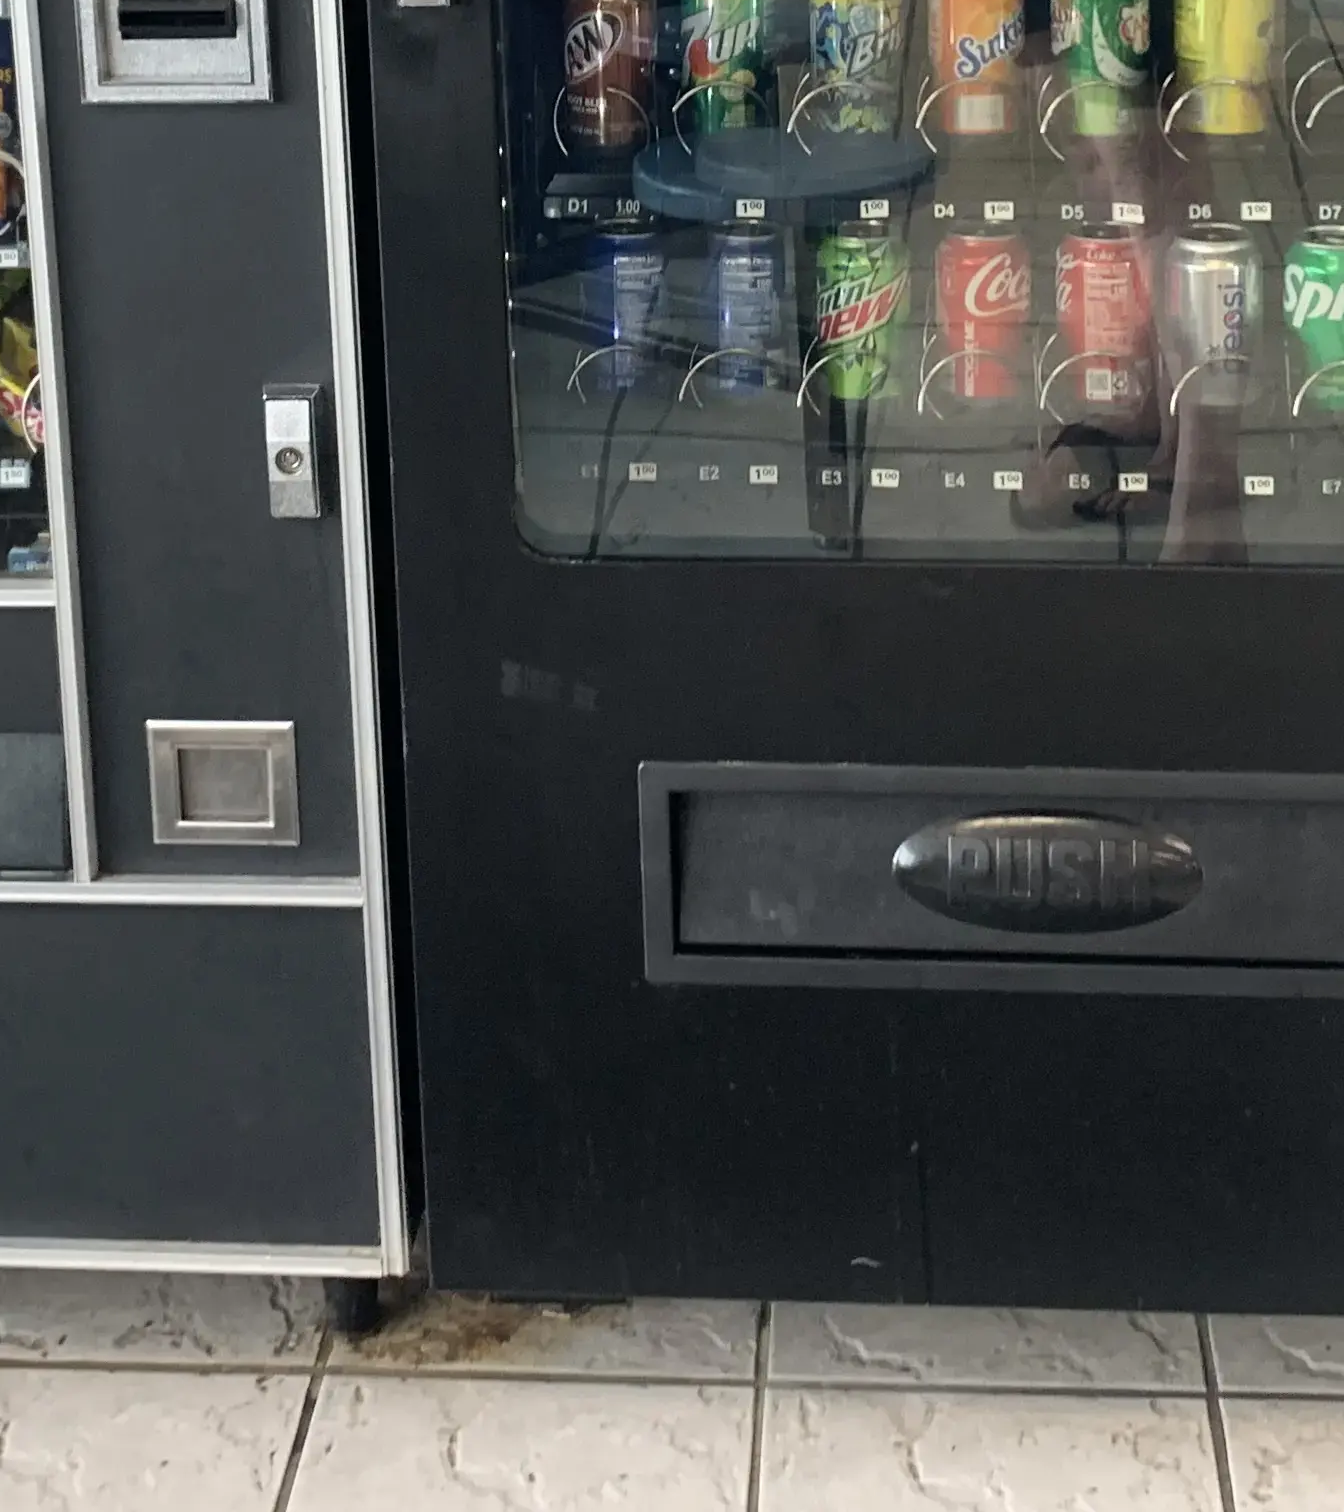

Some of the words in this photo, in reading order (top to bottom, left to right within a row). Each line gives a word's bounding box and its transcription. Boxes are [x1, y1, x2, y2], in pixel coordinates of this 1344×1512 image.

[568, 200, 589, 214] D1
[616, 199, 640, 214] 1.00
[934, 204, 955, 219] D4
[1061, 205, 1084, 220] D5
[1189, 205, 1212, 219] D6
[1319, 205, 1341, 219] D7
[947, 833, 1151, 912] PUSH
